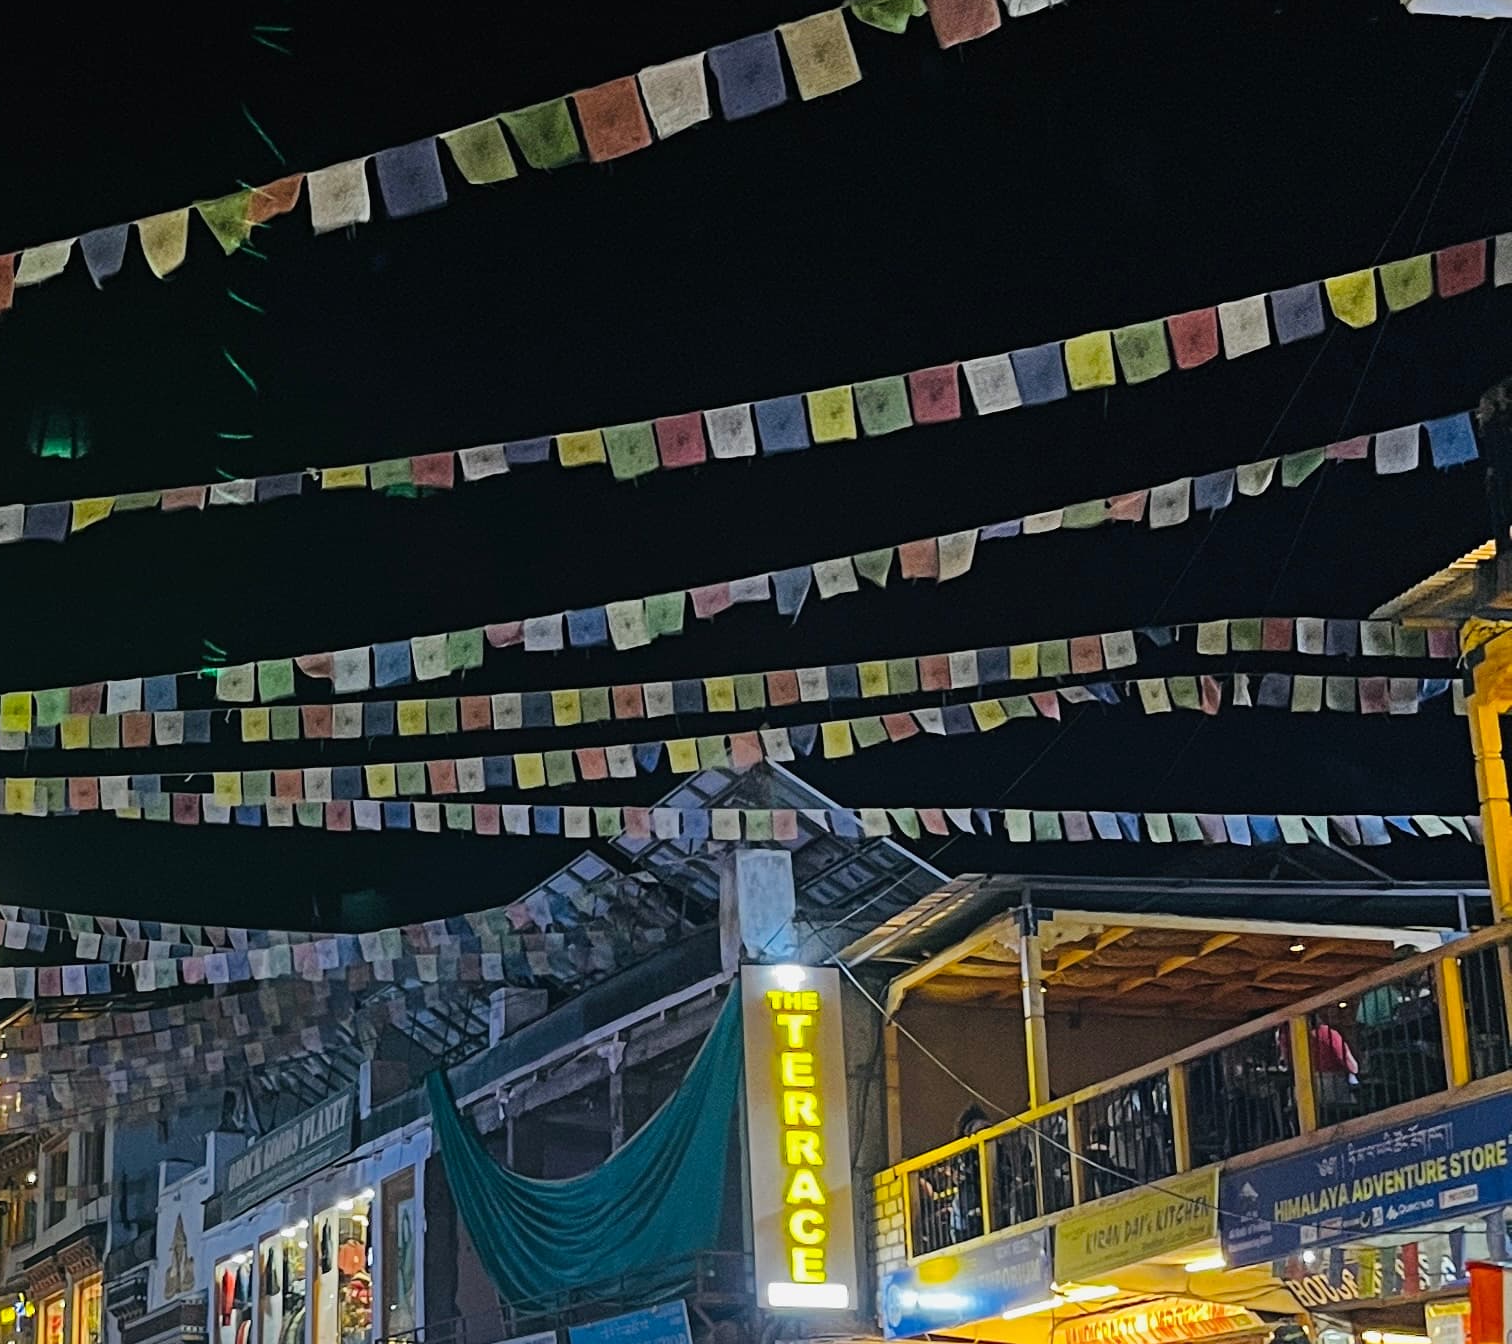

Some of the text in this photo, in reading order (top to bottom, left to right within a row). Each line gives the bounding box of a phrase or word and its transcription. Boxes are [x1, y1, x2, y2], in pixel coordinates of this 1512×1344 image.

[767, 991, 820, 1012] THE
[776, 1013, 827, 1285] TERRACE
[1274, 1183, 1350, 1222] HIMALAYA
[1352, 1156, 1448, 1203] ADVENTURE
[1449, 1139, 1508, 1178] STORE
